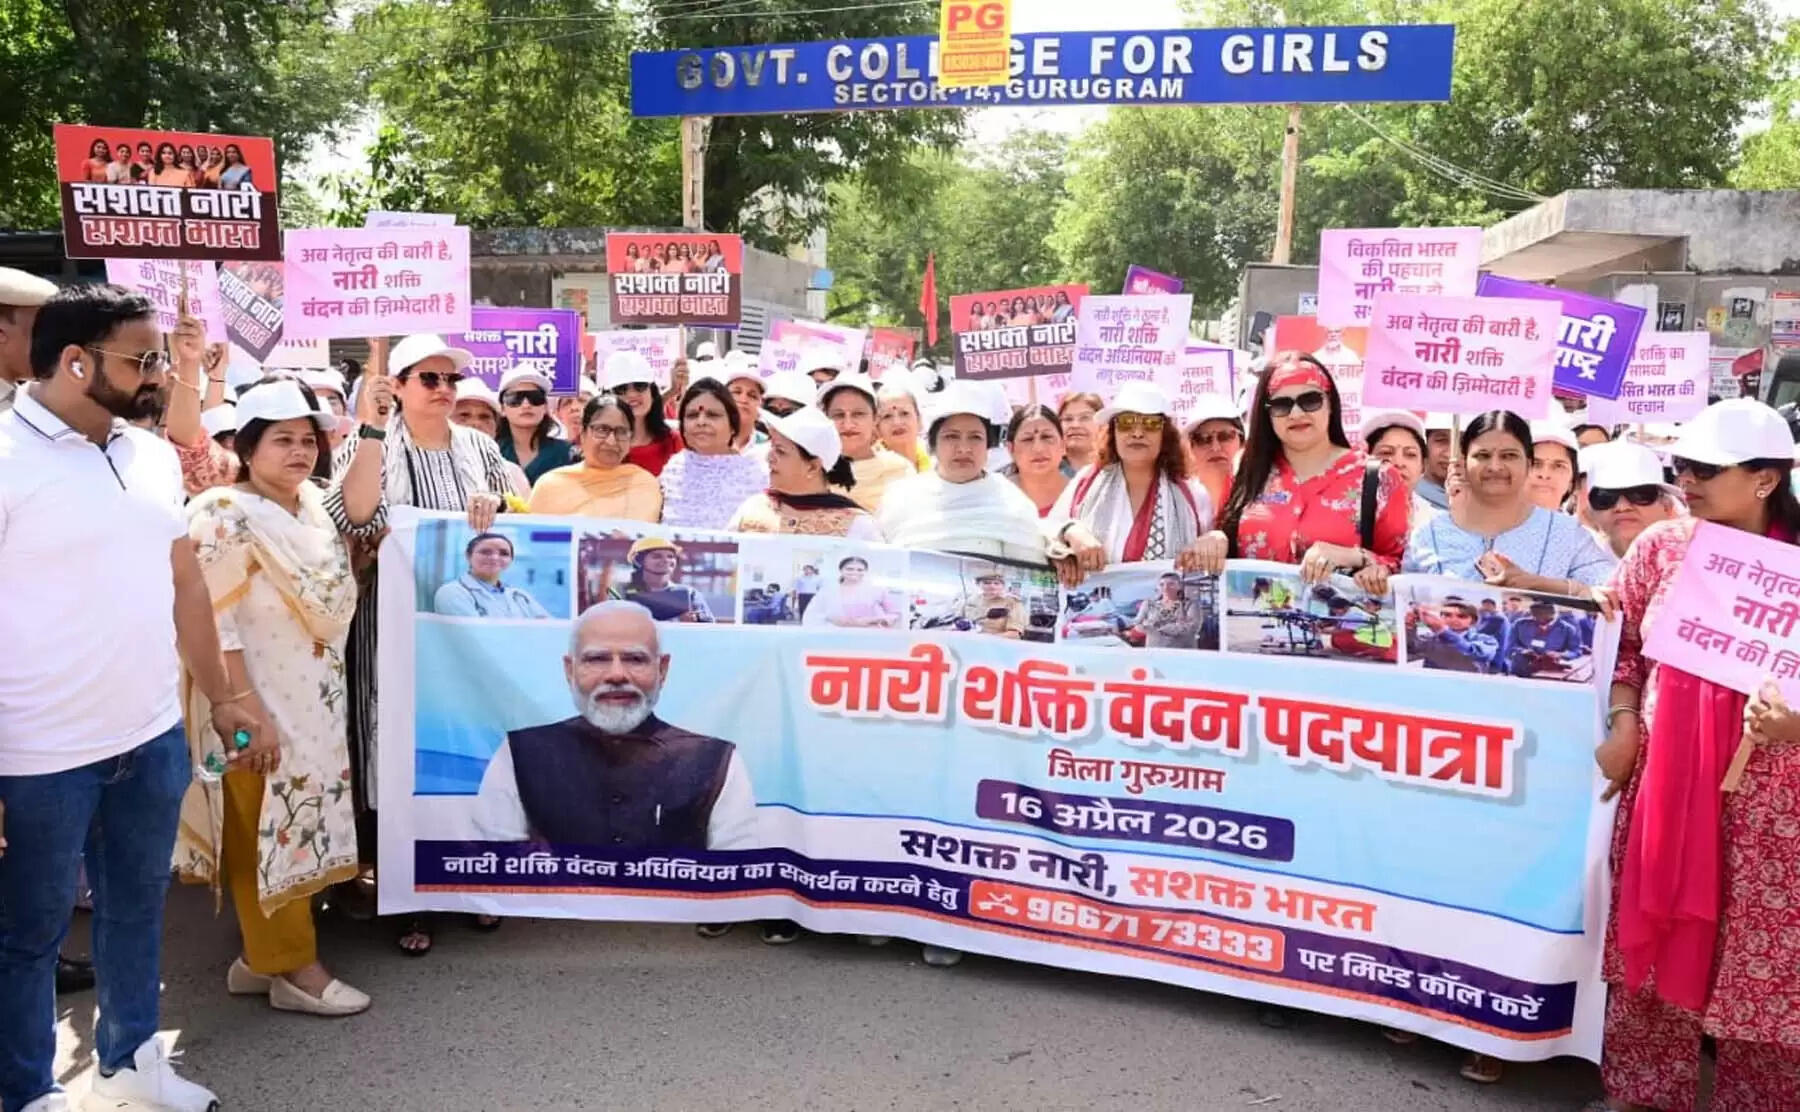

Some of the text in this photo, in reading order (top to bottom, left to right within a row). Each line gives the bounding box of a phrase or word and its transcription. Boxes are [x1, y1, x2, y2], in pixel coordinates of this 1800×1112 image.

[948, 3, 1004, 31] PG
[676, 30, 1389, 89] GOVT. COLGE FOR GIRLS
[70, 182, 262, 219] सशक्त नारी
[80, 215, 260, 248] सशक्त भारत
[302, 248, 328, 263] अब
[332, 244, 372, 266] नेतृत्व
[376, 242, 398, 260] की
[402, 240, 433, 259] बारी
[1347, 238, 1458, 258] विकसित भारत
[332, 264, 422, 290] नारी शक्ति
[615, 267, 730, 294] सशक्त नारी
[1362, 259, 1443, 279] की पहचान
[302, 297, 344, 318] वंदन
[348, 297, 371, 316] की
[445, 293, 455, 314] है
[617, 295, 728, 316] सशक्त भारत
[504, 324, 558, 355] नारी
[960, 325, 1027, 352] सशक्त
[1100, 321, 1160, 344] नारी शक्ति
[1386, 313, 1540, 342] अब नेतृत्व की बारी है,
[965, 349, 1027, 373] सशक्त
[1105, 345, 1164, 365] अधिनियम
[1415, 337, 1504, 367] नारी शक्ति
[1640, 345, 1666, 361] शक्ति
[1669, 347, 1685, 360] का
[1381, 366, 1423, 390] वंदन
[1427, 371, 1447, 391] की
[1452, 371, 1521, 396] ज़िम्मेदारी
[1524, 380, 1536, 398] है
[1648, 384, 1675, 396] भारत
[1678, 380, 1695, 396] की
[1628, 402, 1665, 413] पहचान
[1704, 553, 1744, 579] अब
[1733, 596, 1800, 638] नारी
[1677, 617, 1736, 654] वंदन
[1735, 639, 1770, 667] की
[806, 643, 1514, 790] नारी शक्ति वंदन पदयात्रा
[1048, 748, 1226, 795] जिला गुरुग्राम
[1000, 791, 1268, 850] 16 अप्रैल 2026
[900, 829, 1379, 932] सशक्त नारी, सशक्त भारत
[442, 852, 1546, 1021] नारी शक्ति वंदन अधिनियम का समर्थन करने हेतु 96671 73333 पर मिस्ड कॉल करें
